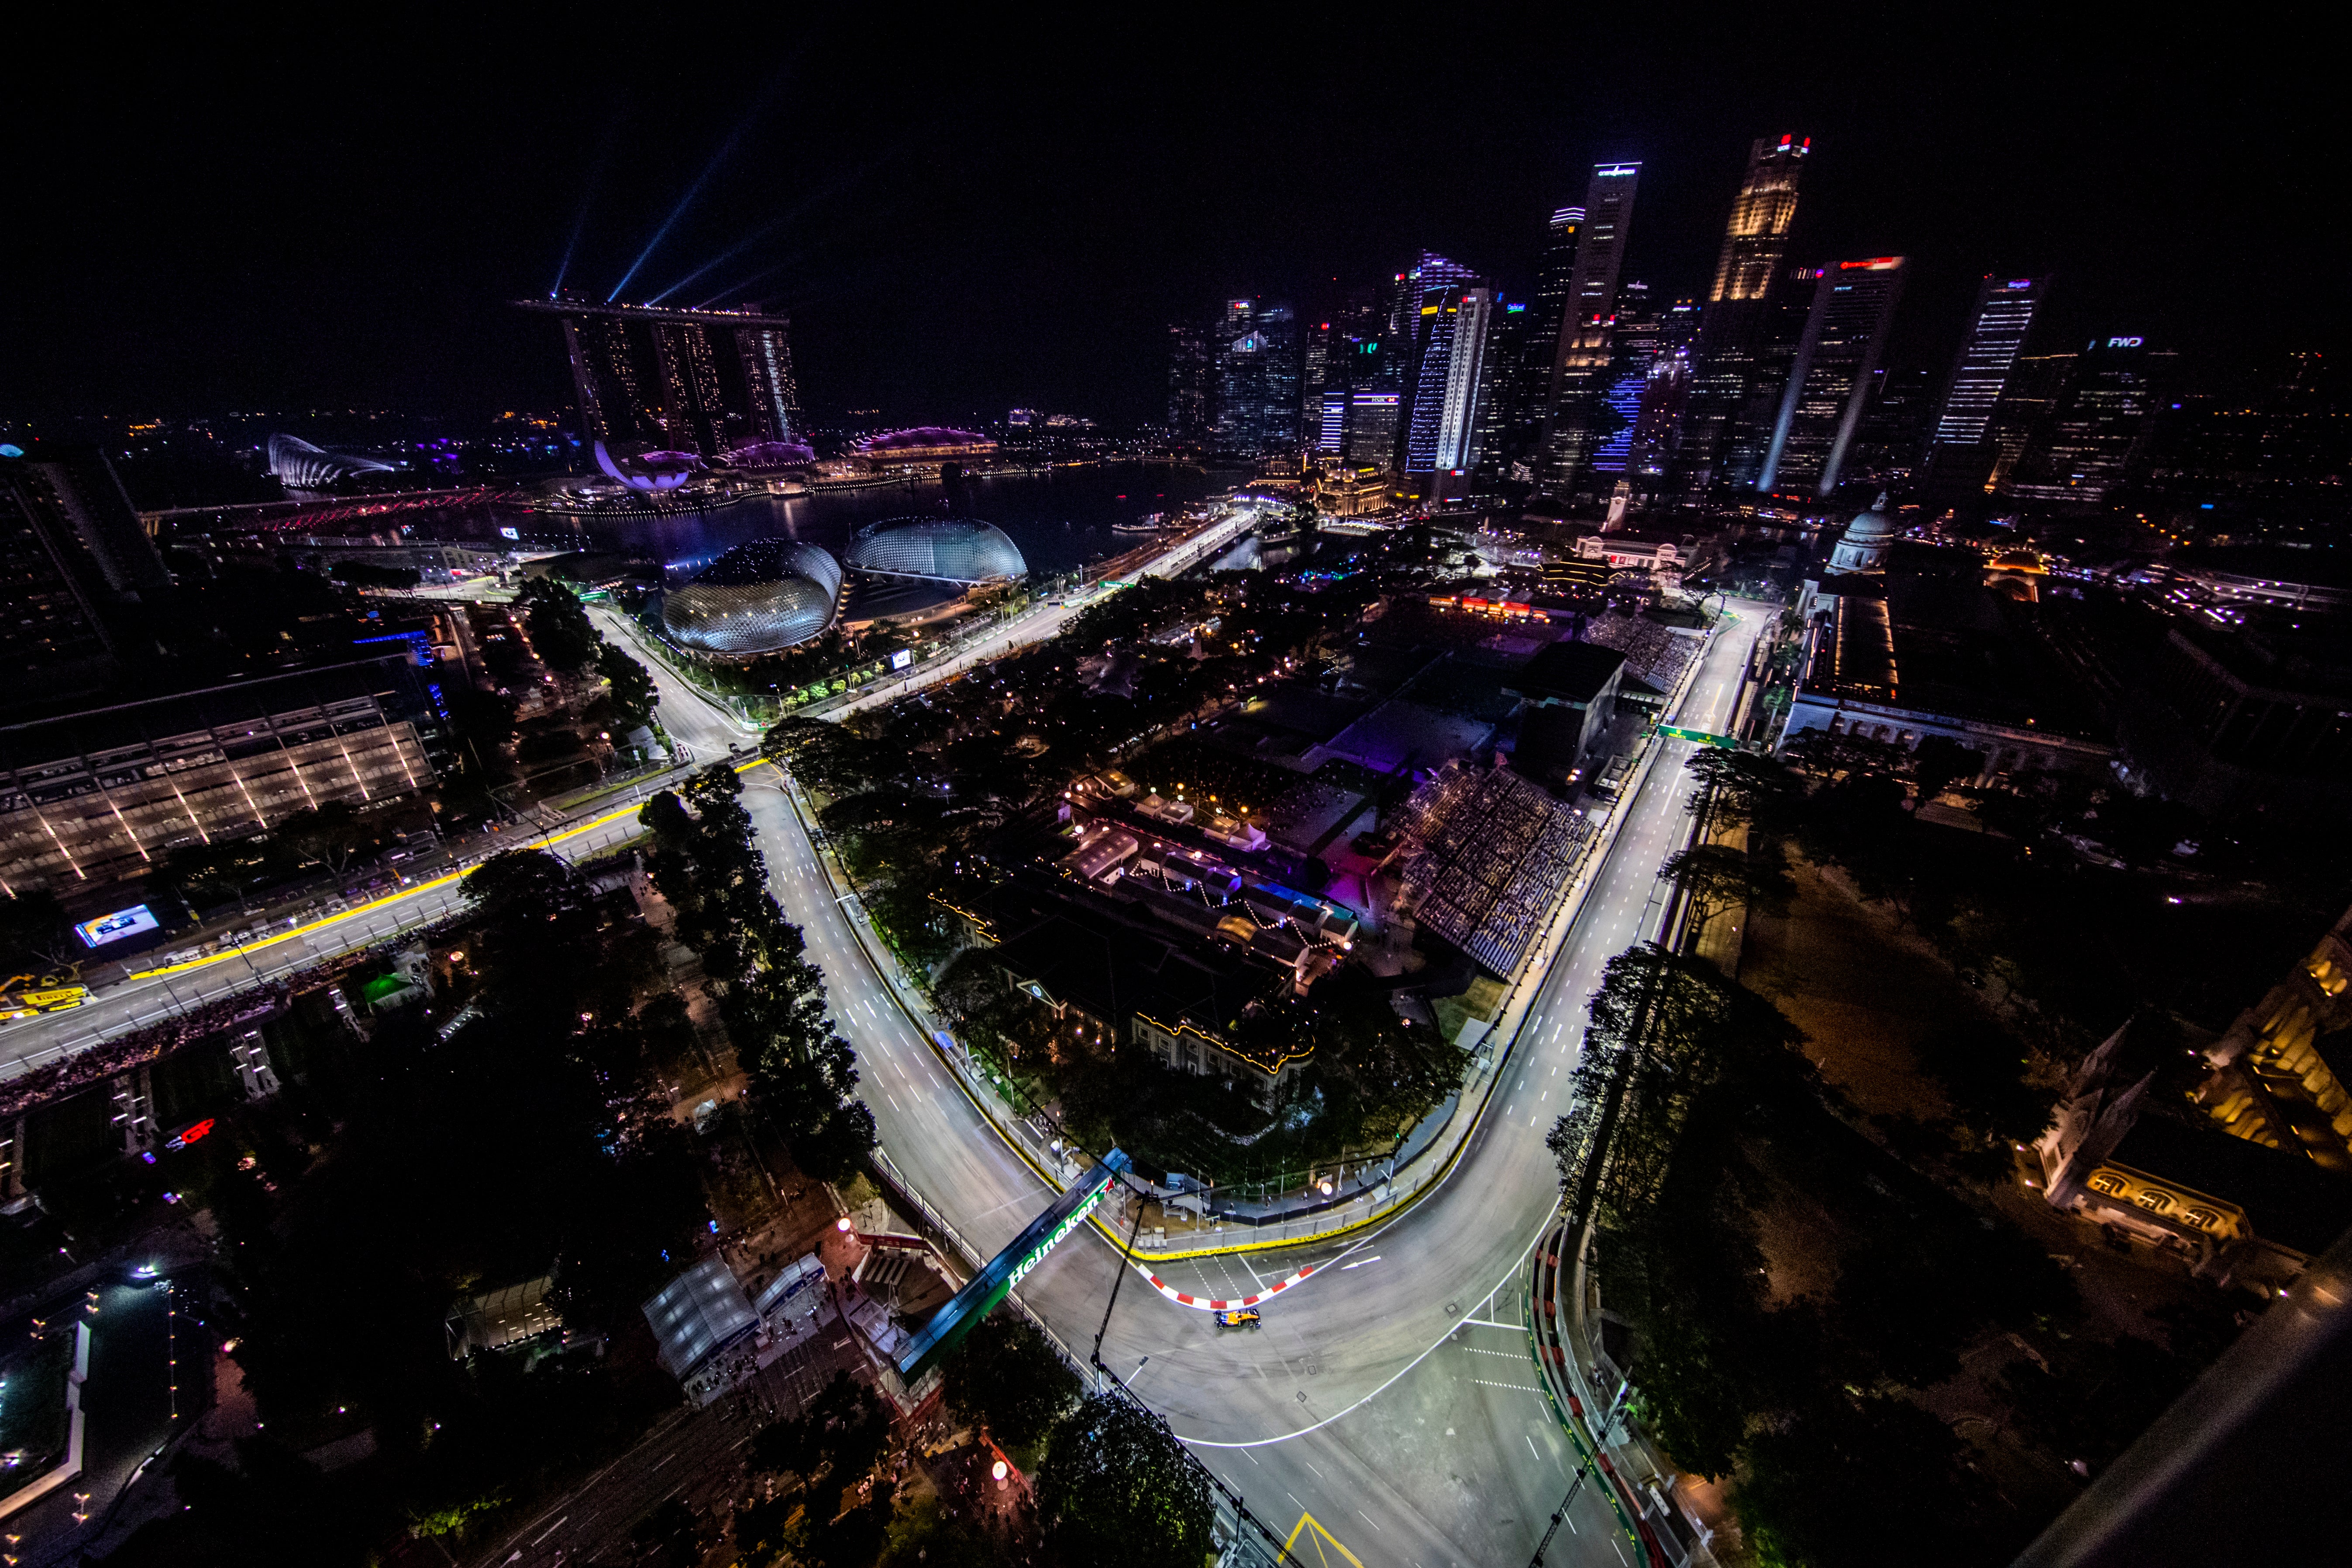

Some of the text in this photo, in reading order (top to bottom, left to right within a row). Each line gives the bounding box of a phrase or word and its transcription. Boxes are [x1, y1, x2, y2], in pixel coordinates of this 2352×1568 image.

[2108, 337, 2143, 347] FWD
[1297, 1224, 1355, 1242] SINGAPORE
[1008, 1195, 1099, 1290] Heineken
[1174, 1247, 1237, 1257] SINGAPORE
